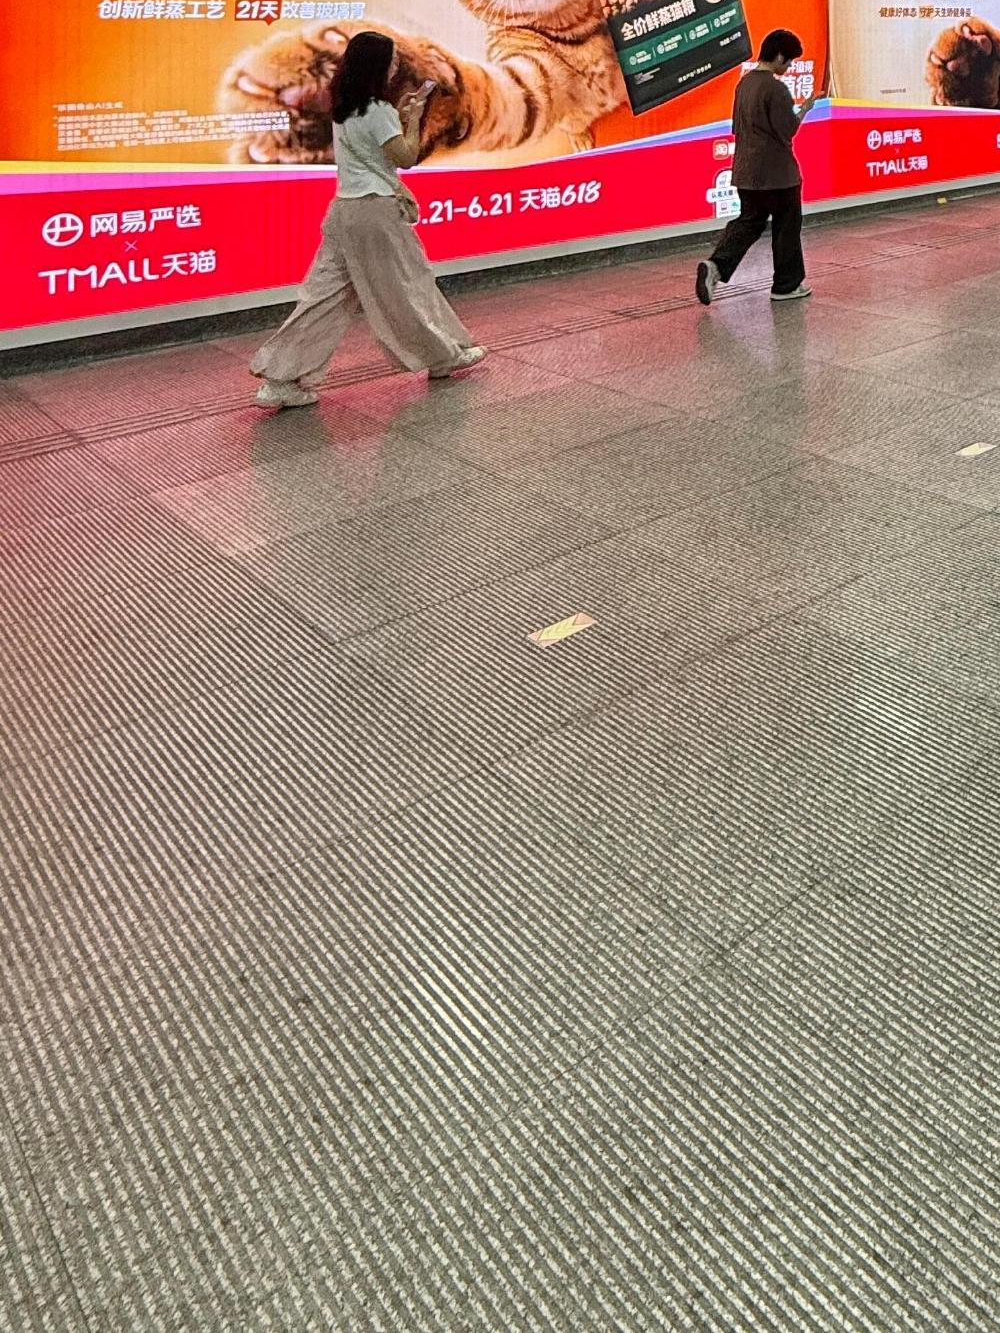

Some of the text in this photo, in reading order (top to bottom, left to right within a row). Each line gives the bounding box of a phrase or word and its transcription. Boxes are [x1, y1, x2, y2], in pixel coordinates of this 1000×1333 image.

[882, 128, 922, 146] 网易严选
[866, 155, 928, 178] TMALL天猫
[420, 180, 601, 225] .21-6.21 天猫618
[90, 204, 202, 238] 网易严选
[38, 249, 216, 295] TMALL天猫
